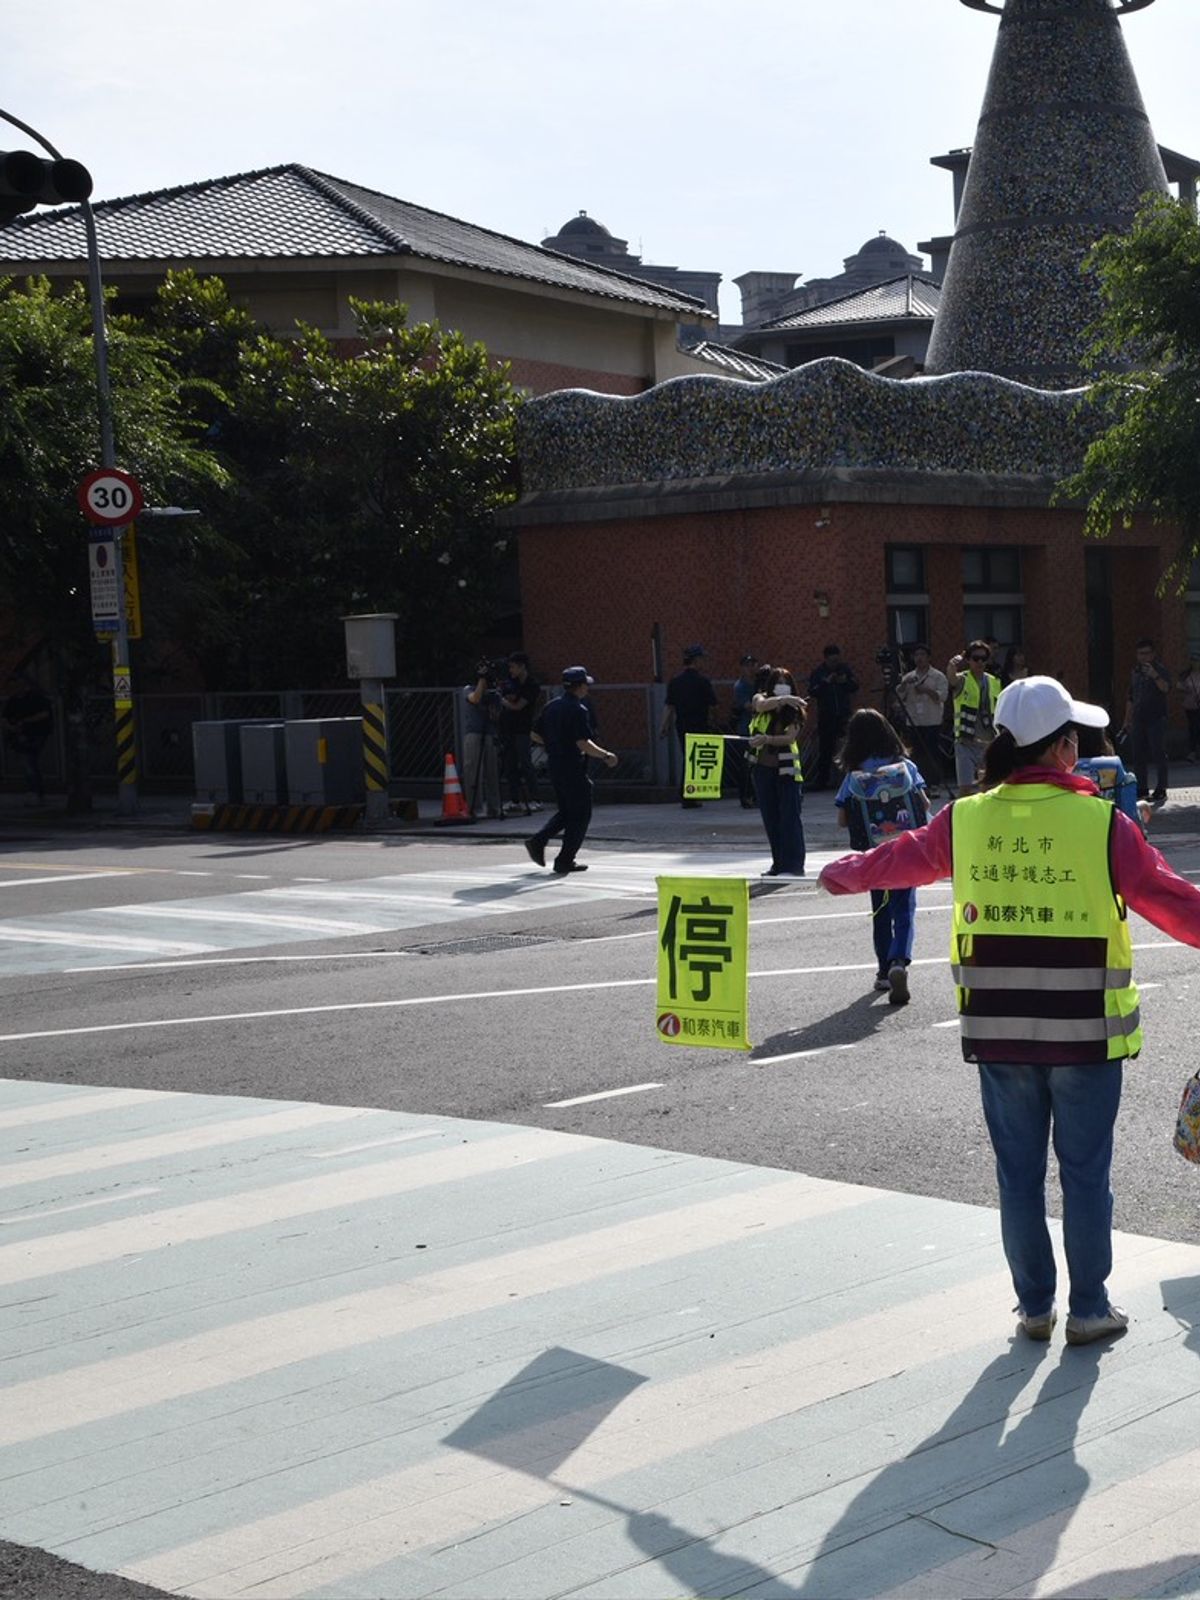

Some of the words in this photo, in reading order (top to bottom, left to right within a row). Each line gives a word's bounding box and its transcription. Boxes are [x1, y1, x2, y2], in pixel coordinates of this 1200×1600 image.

[93, 487, 127, 509] 30
[689, 741, 719, 780] 停
[987, 834, 1054, 854] 新北市
[969, 864, 1076, 884] 交通導護志工
[984, 904, 1055, 923] 和泰汽車
[661, 895, 734, 1002] 停
[682, 1016, 741, 1039] 和泰汽車
